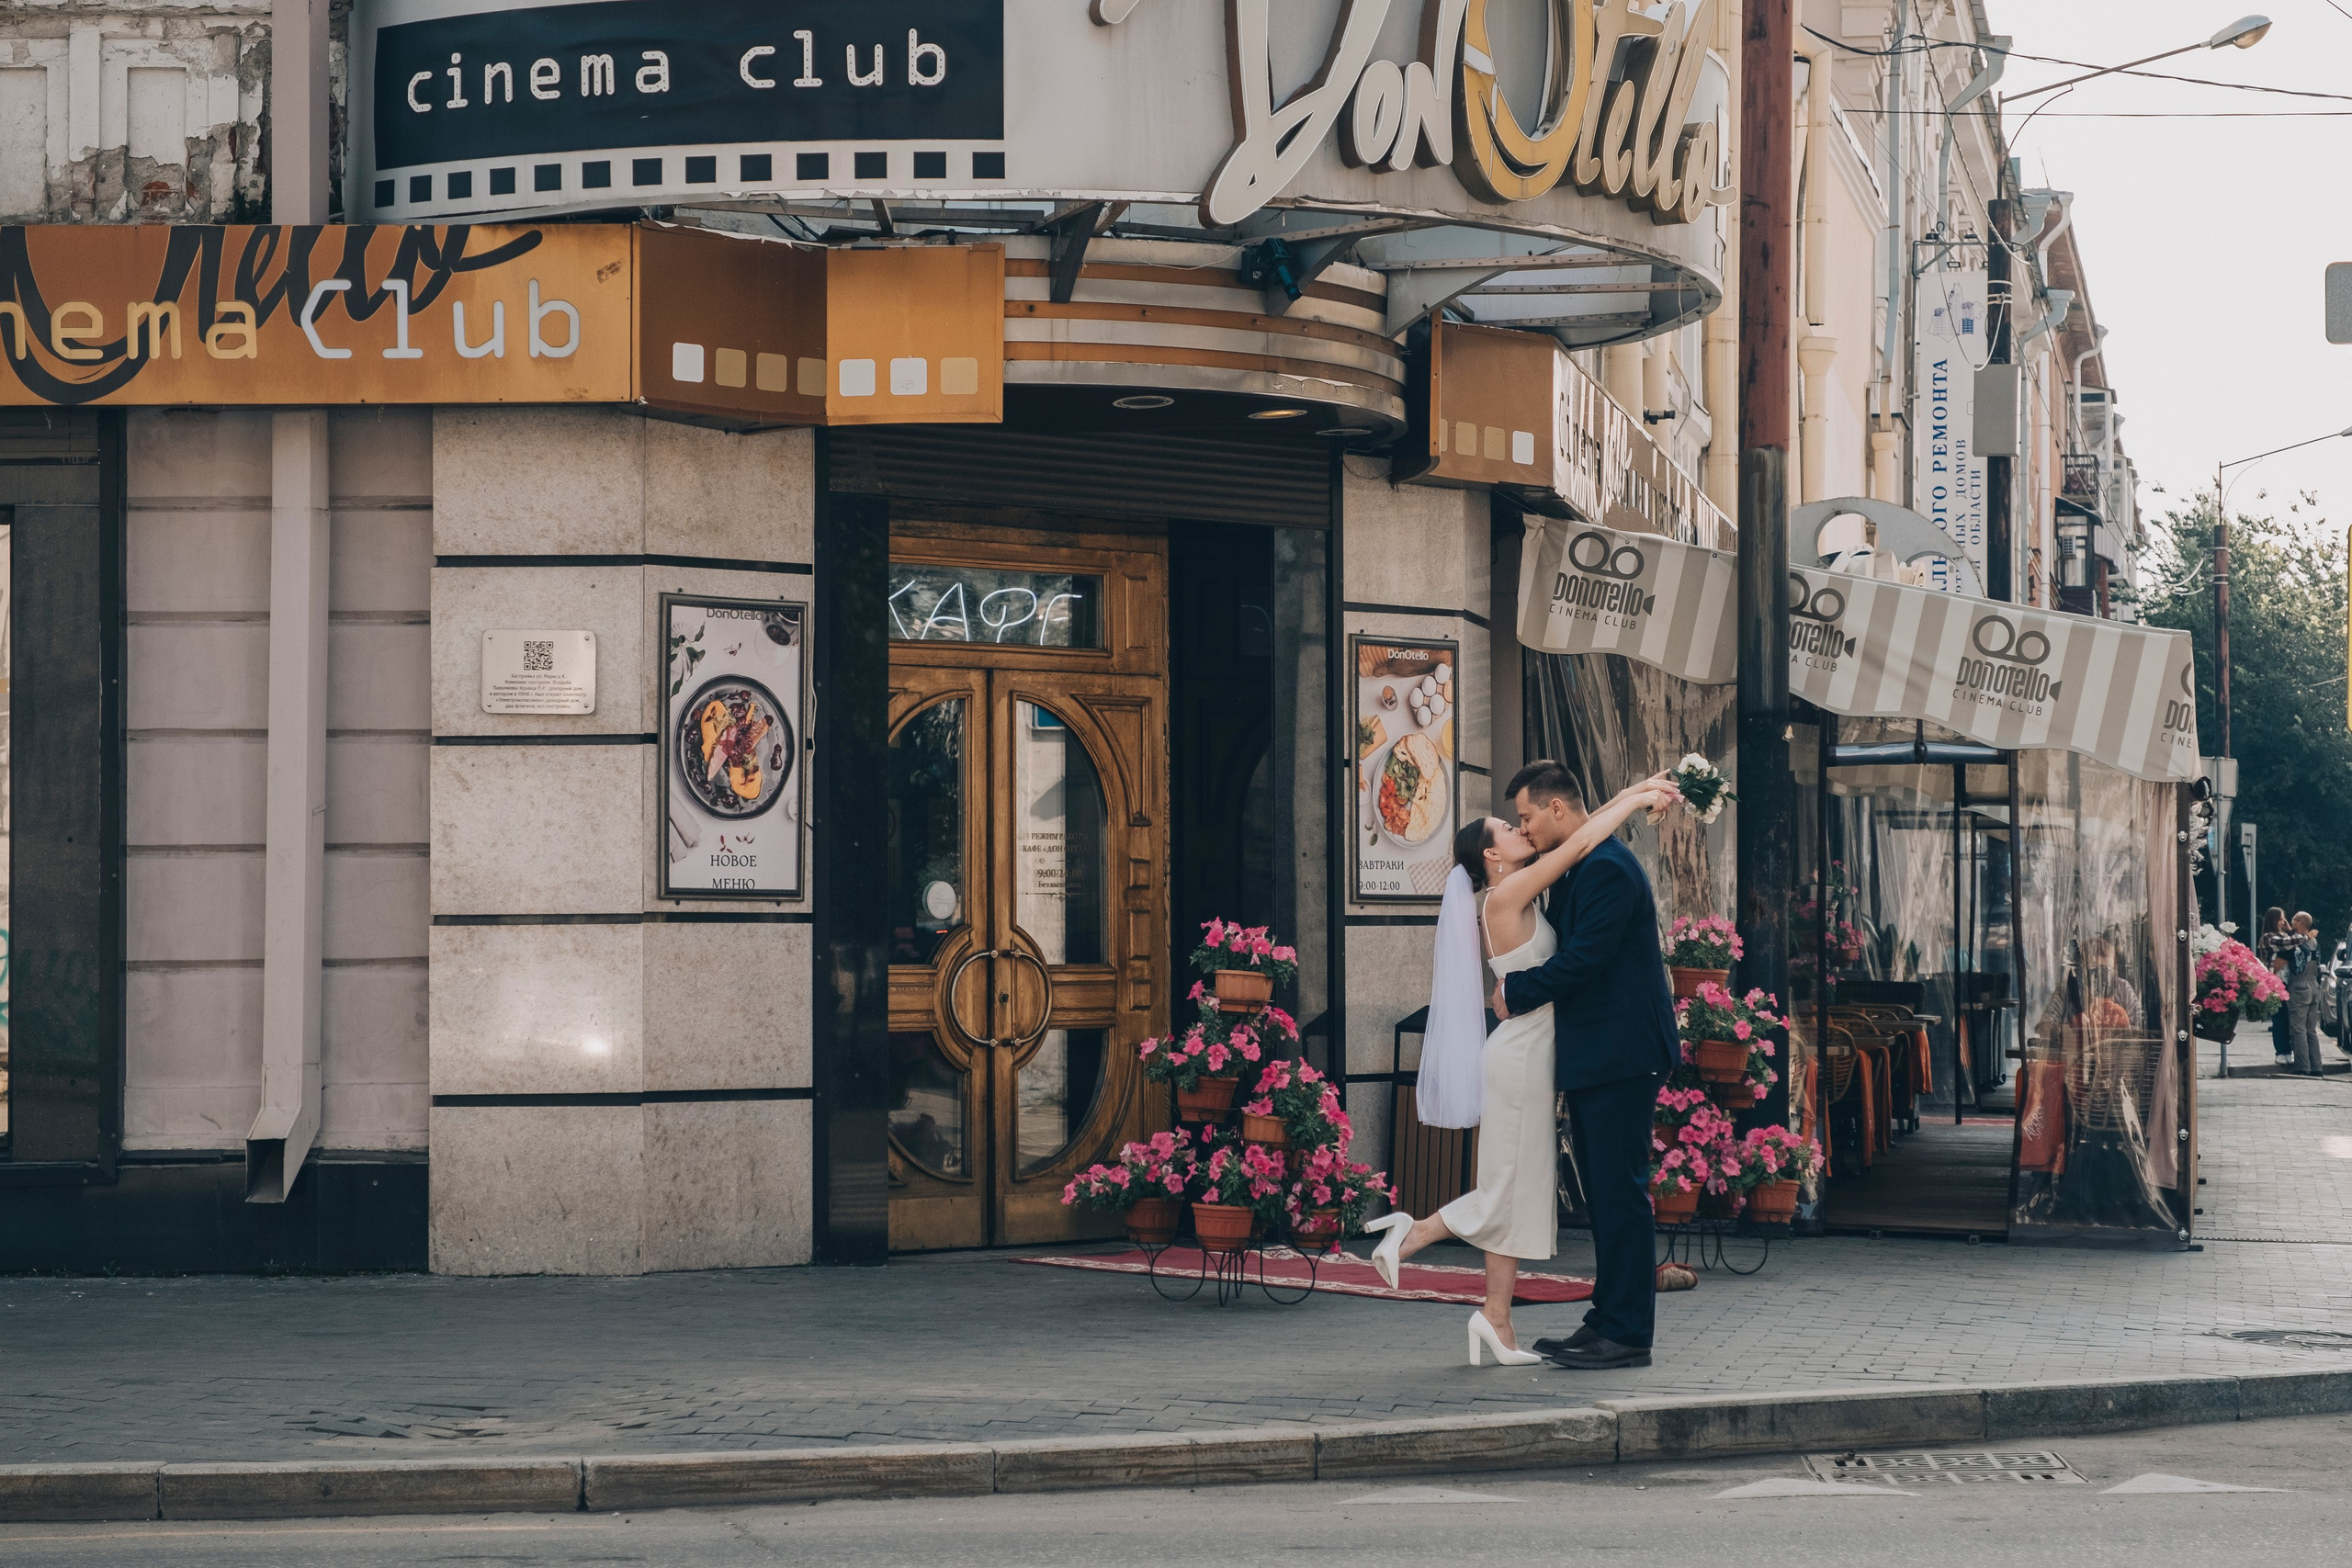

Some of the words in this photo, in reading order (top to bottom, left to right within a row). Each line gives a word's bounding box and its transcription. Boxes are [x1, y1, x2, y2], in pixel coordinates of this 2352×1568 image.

[407, 50, 671, 113] cinema
[739, 28, 946, 89] club
[1931, 357, 1948, 474] РЕМОНТА
[1955, 439, 1968, 500] ДОМОВ
[1970, 469, 1982, 546] ОБЛАСТИ
[706, 607, 763, 621] DonOtello
[1549, 604, 1598, 623] CINEMA
[1604, 615, 1637, 630] CLUB
[1387, 649, 1430, 661] DonOtello
[1805, 657, 1838, 672] CLUB
[1952, 688, 2003, 708] CINEMA
[2009, 700, 2043, 716] CLUB
[2160, 732, 2192, 749] CINE
[1031, 832, 1058, 840] РЕЖИМ
[1022, 844, 1042, 853] КАФЕ
[710, 854, 757, 867] НОВОЕ
[712, 878, 756, 890] МЕНЮ
[1038, 880, 1049, 888] Без
